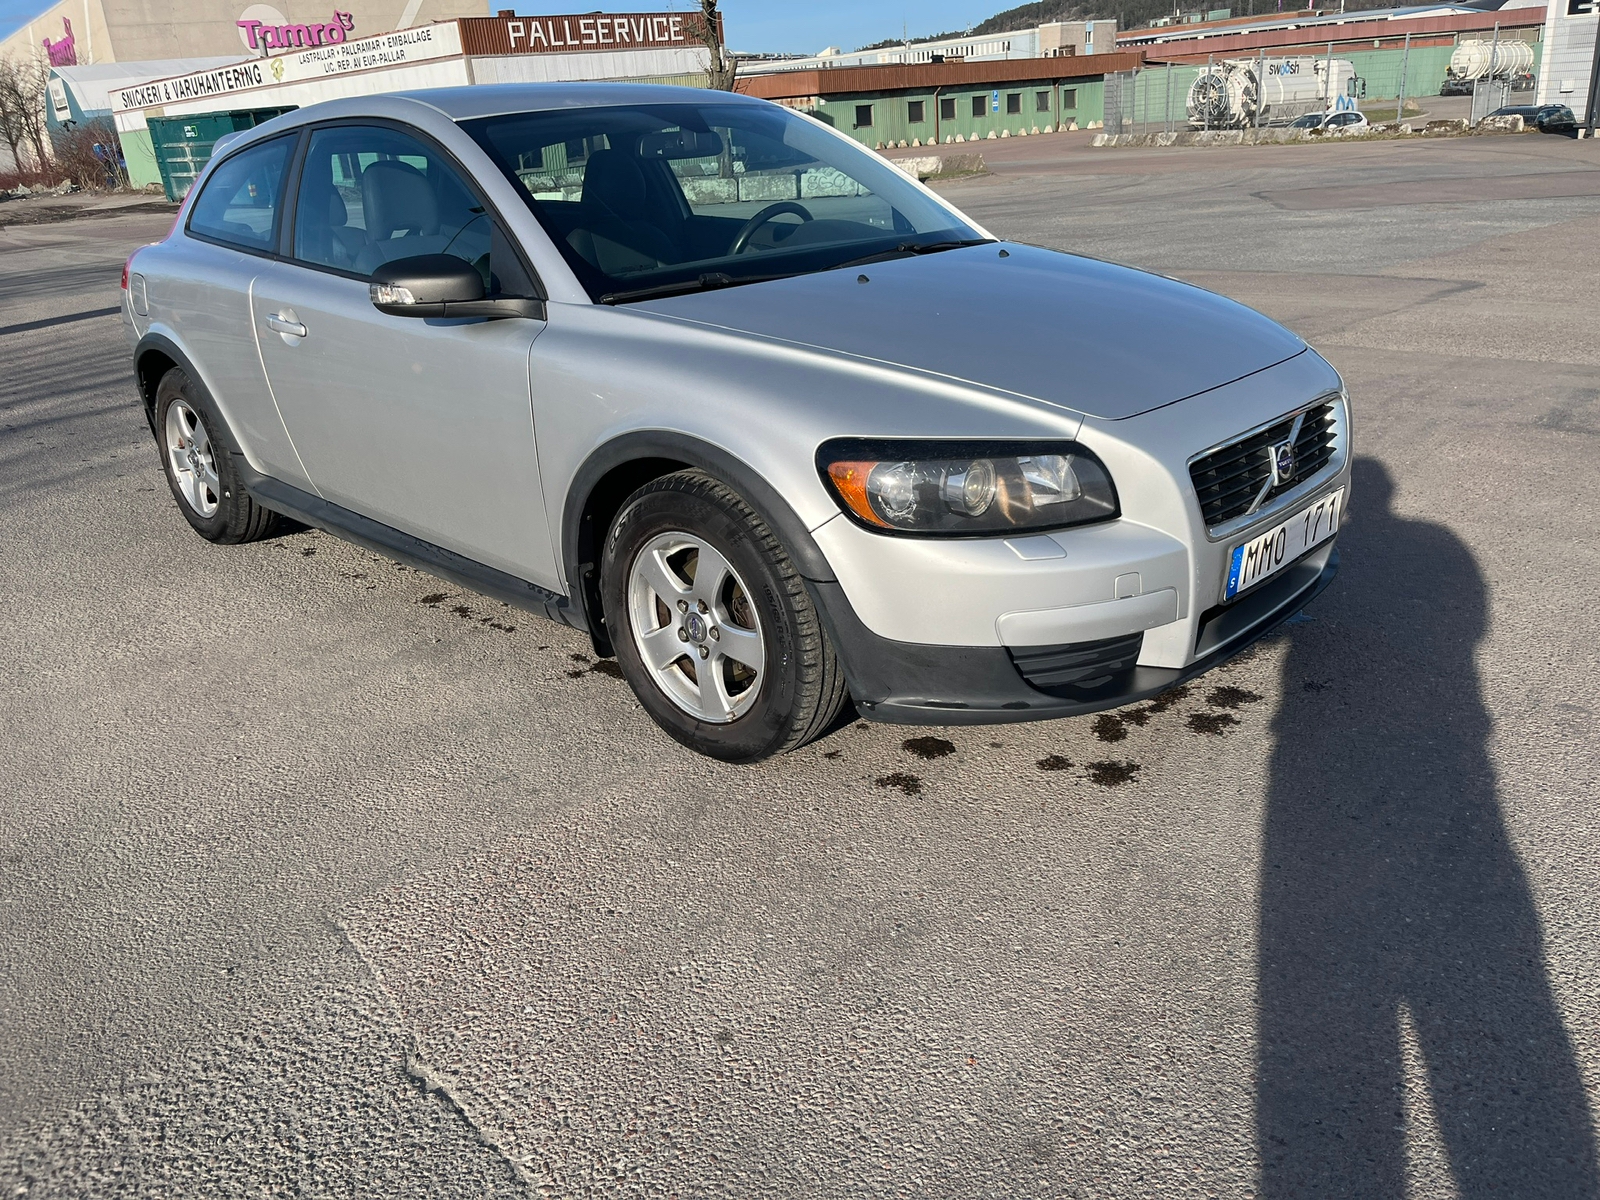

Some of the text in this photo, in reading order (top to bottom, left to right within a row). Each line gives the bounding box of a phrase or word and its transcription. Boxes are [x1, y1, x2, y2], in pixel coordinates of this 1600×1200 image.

[236, 20, 346, 50] Tamro
[298, 29, 432, 65] LASTPALLAR PALLRAMAR EMBALLAGE
[508, 17, 685, 48] PALLSERVICE
[323, 49, 406, 73] LIC. REP. AV EUR-PALLAR
[1269, 60, 1299, 76] swoosh
[121, 63, 263, 109] SNICKERI & VARUHANTERING
[1242, 496, 1337, 585] MMO 171
[1230, 577, 1236, 588] S
